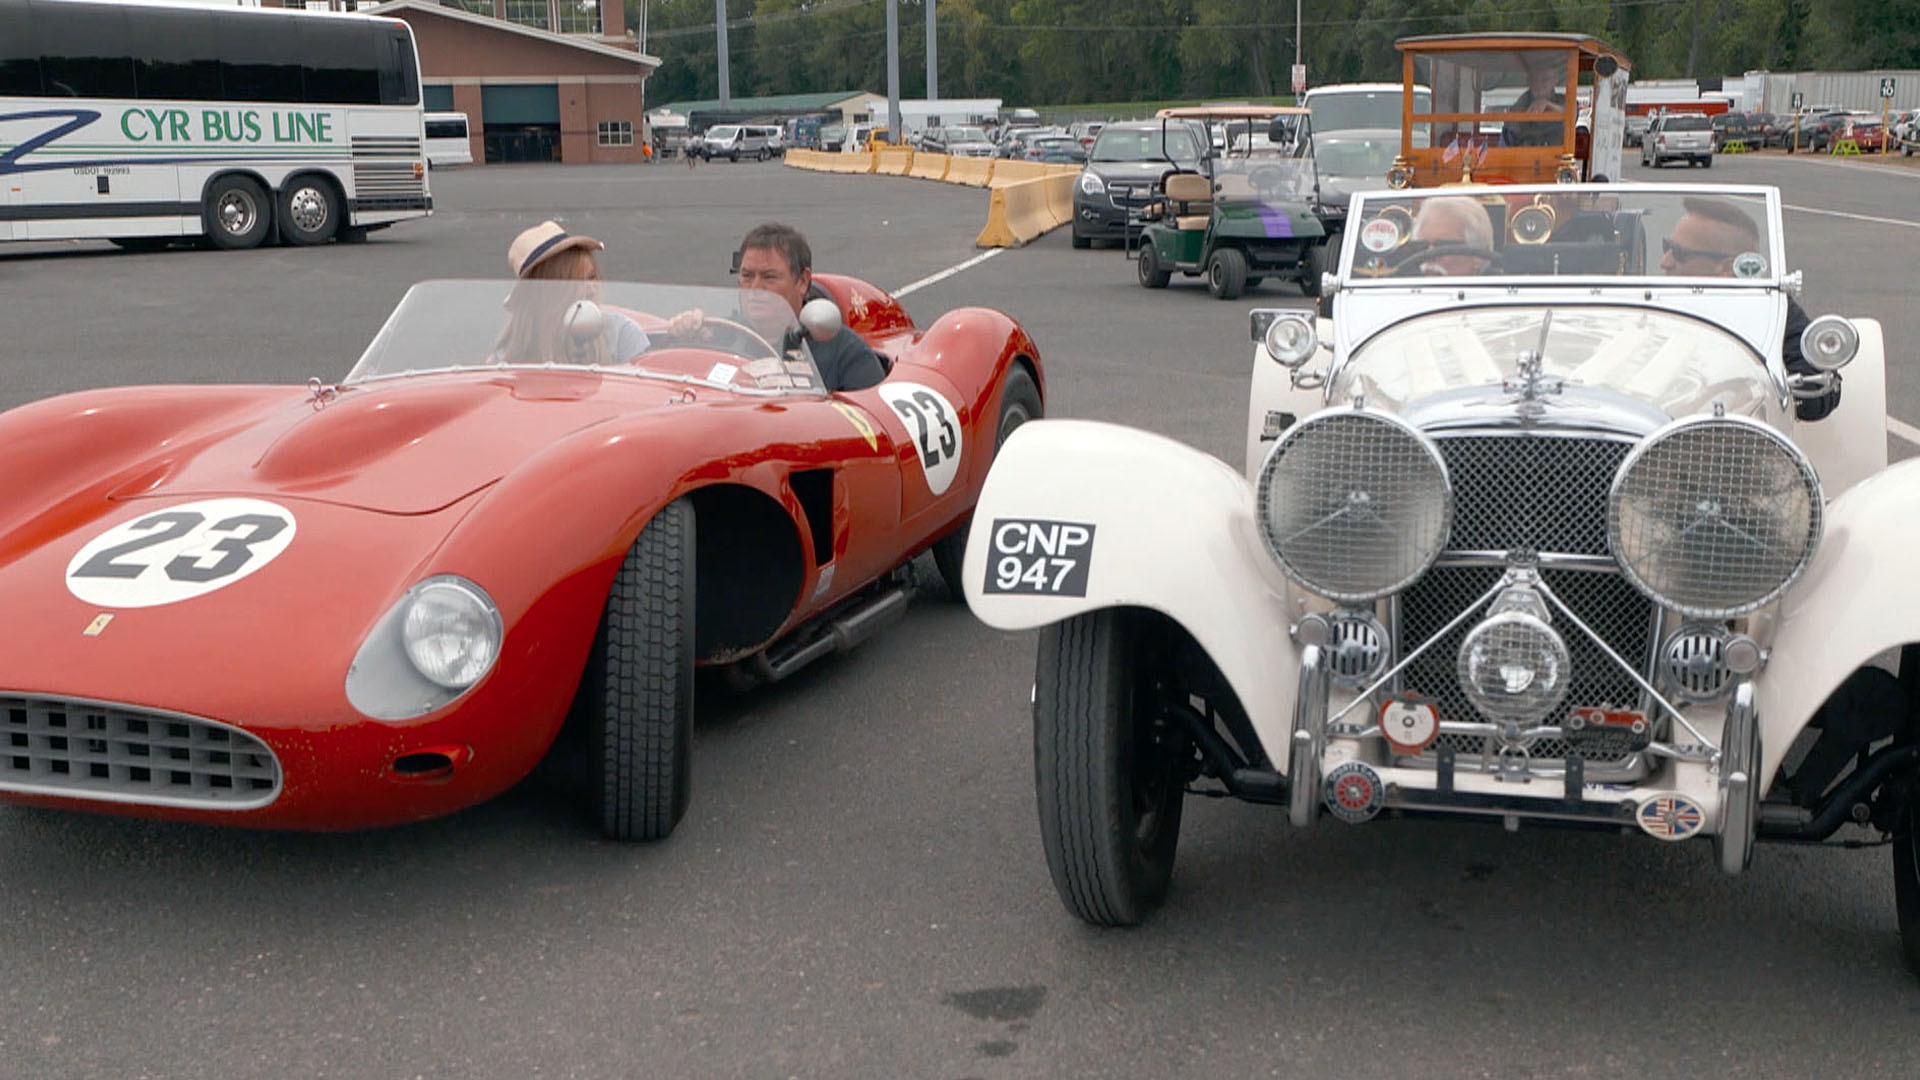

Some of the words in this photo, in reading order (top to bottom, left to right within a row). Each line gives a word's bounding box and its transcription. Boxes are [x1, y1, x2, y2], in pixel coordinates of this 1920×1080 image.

[121, 109, 190, 141] CYR
[203, 110, 261, 142] BUS
[273, 112, 333, 143] LINE
[893, 391, 956, 468] 23
[71, 511, 288, 584] 23
[995, 523, 1089, 556] CNP
[996, 556, 1076, 591] 947
